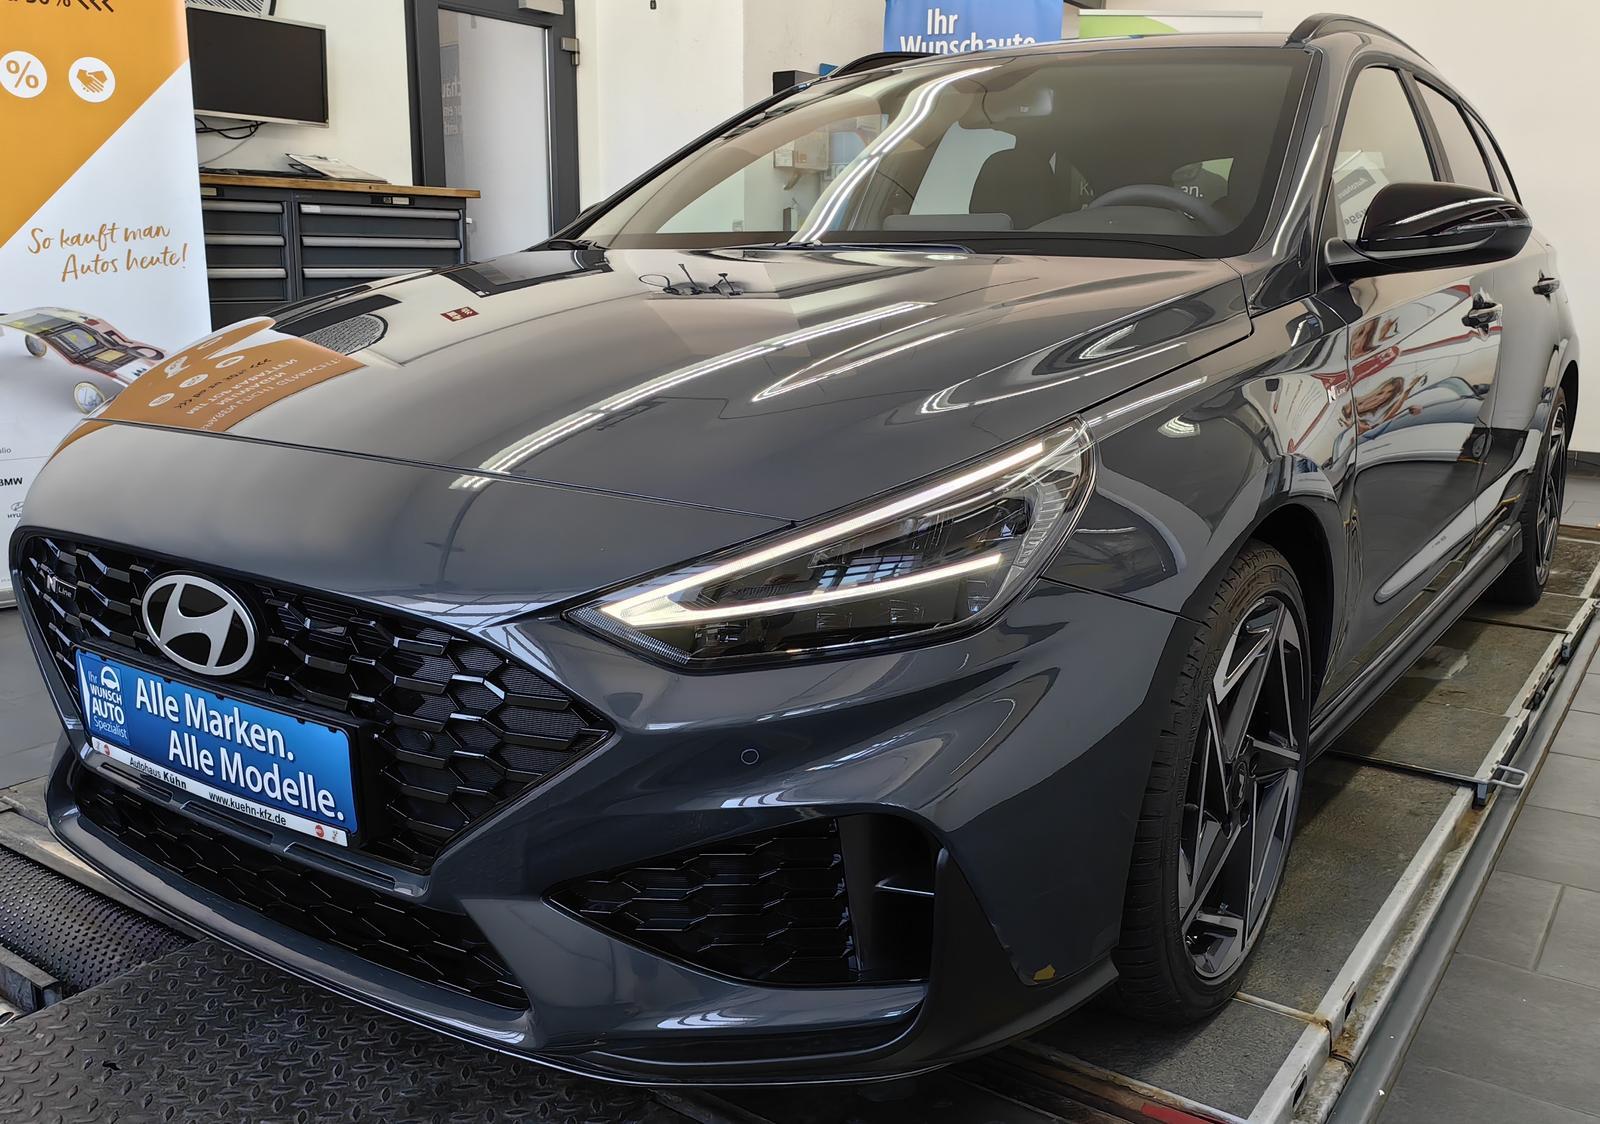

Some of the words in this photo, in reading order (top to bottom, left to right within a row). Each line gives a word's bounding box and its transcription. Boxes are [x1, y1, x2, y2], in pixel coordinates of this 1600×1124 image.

[927, 8, 959, 35] Ihr
[27, 227, 54, 254] So
[60, 222, 120, 252] kauft
[124, 224, 170, 242] man
[61, 253, 118, 282] Autos
[126, 243, 188, 272] heute!
[90, 683, 122, 705] WUNSCH
[92, 696, 125, 725] AUTO
[135, 677, 180, 723] Alle
[184, 692, 294, 761] Marken.
[93, 715, 128, 740] Spezialist
[129, 757, 162, 780] Autohaus
[163, 771, 187, 790] Kühn
[168, 729, 215, 776] Alle
[219, 746, 345, 821] Modelle.
[208, 791, 287, 826] www.kuehn-kfz.de
